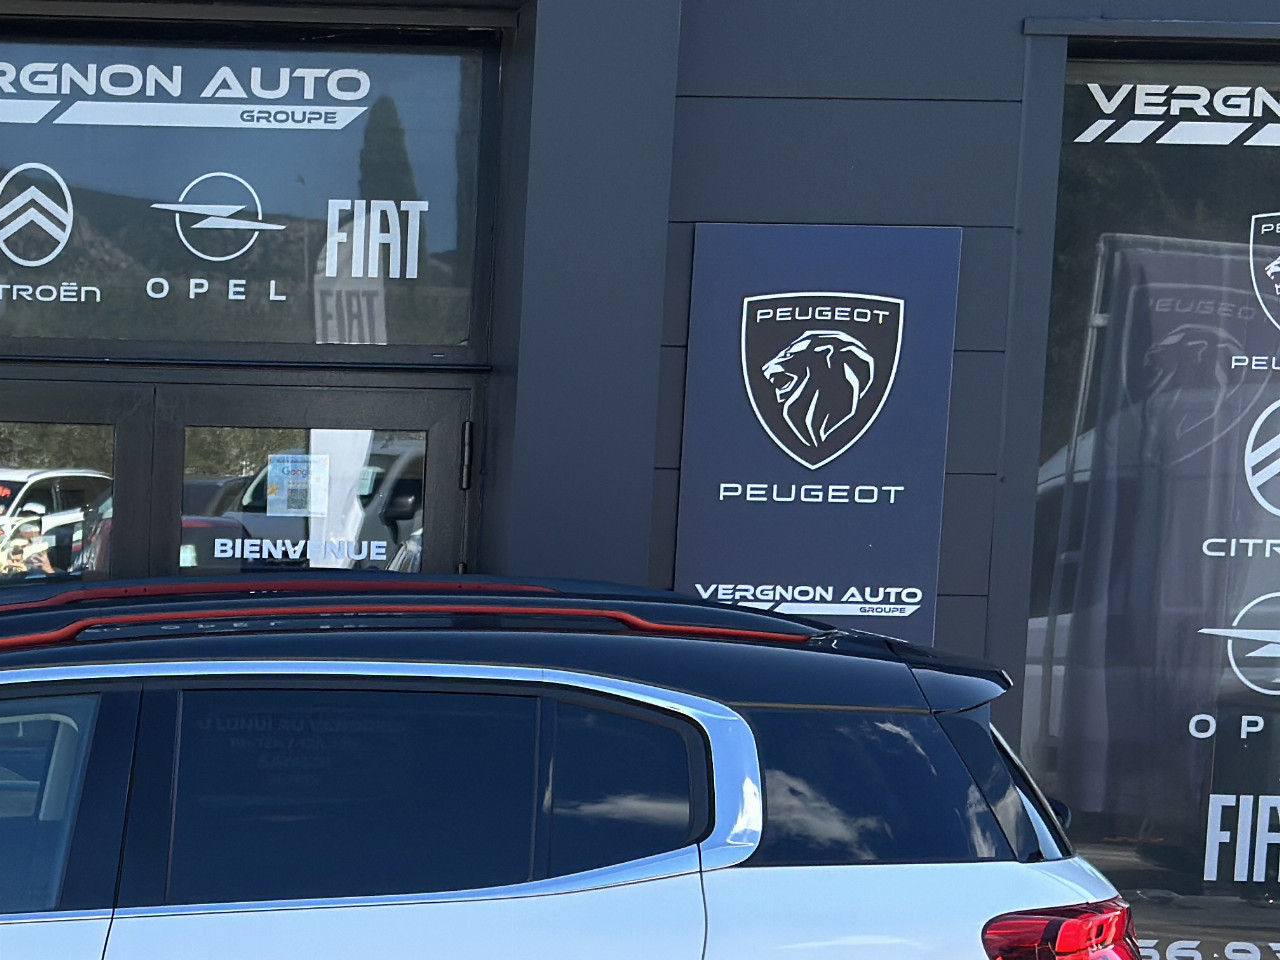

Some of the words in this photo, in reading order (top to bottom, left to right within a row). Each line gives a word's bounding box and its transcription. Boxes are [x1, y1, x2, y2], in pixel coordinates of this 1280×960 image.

[200, 66, 372, 100] AUTO
[239, 109, 338, 125] GROUPE
[325, 199, 429, 279] FIAT
[146, 277, 287, 301] OPEL
[756, 306, 890, 324] PEUGEOT
[719, 483, 905, 504] PEUGEOT
[214, 538, 388, 561] BIENVENUE
[694, 583, 834, 602] VERGNON
[840, 586, 923, 603] AUTO
[859, 606, 906, 614] GROUPE
